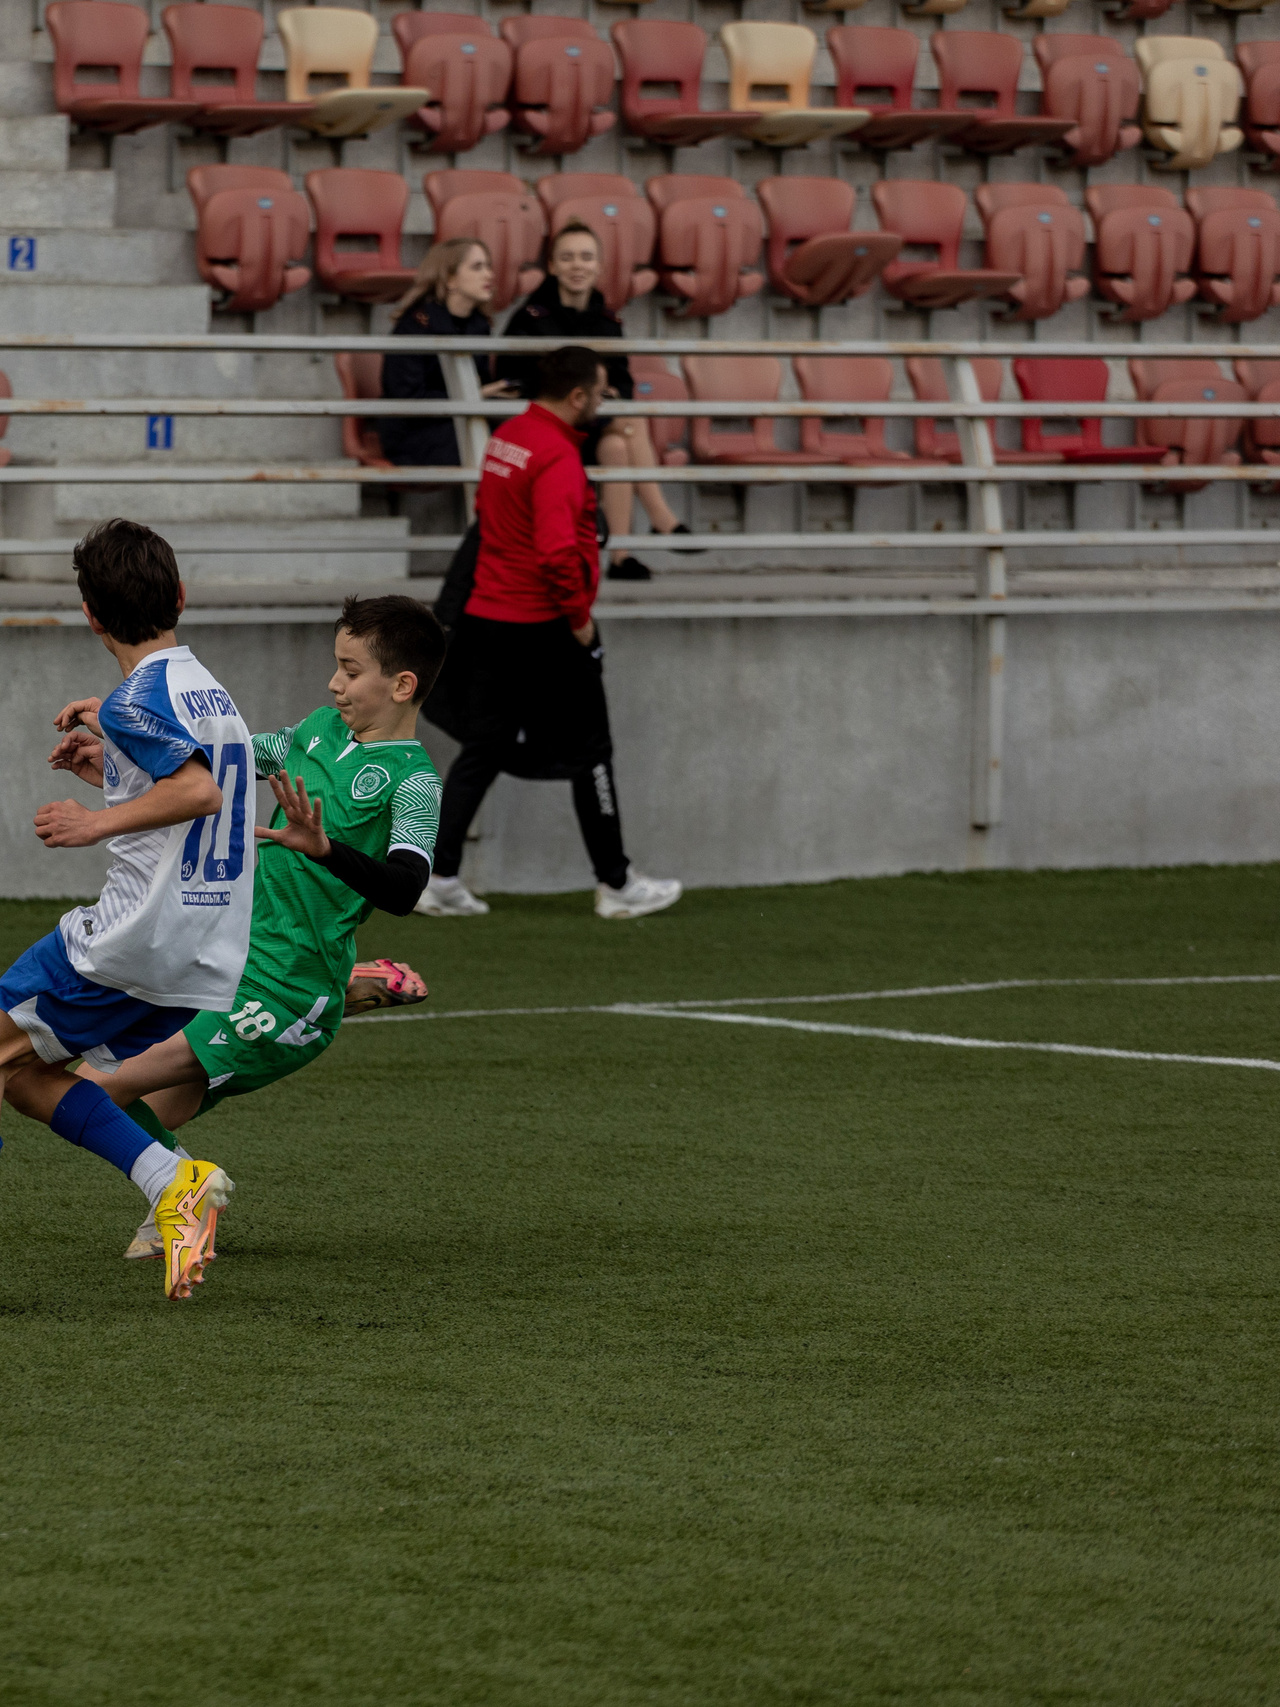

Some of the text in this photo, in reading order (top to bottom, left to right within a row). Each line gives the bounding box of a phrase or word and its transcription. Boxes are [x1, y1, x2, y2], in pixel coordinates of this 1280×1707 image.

[14, 239, 31, 270] 2
[152, 417, 167, 450] 1
[228, 1000, 277, 1041] 18
